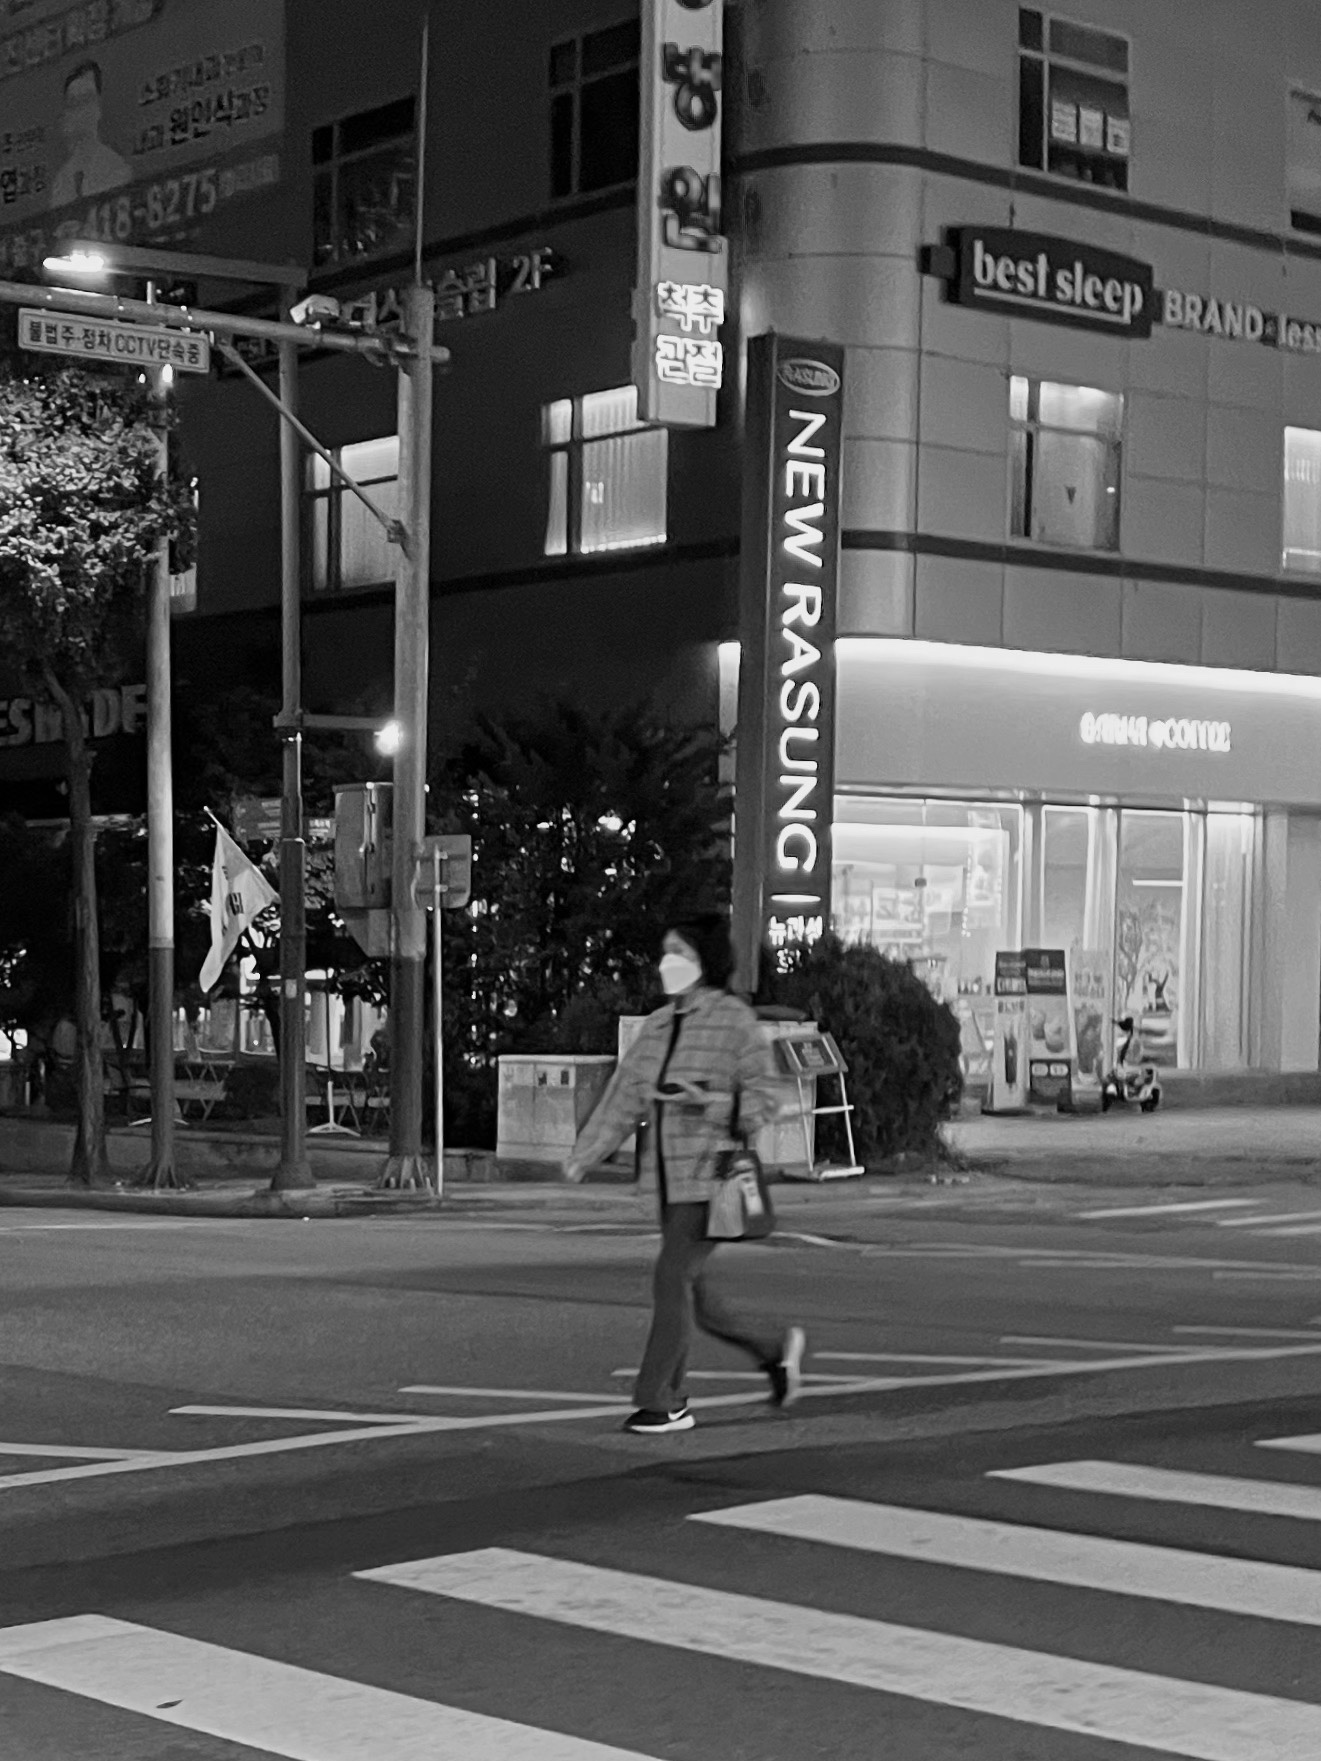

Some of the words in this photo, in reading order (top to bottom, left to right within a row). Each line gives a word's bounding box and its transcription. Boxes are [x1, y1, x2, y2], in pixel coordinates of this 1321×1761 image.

[660, 0, 722, 255] 병원
[657, 279, 724, 335] 척추
[973, 239, 1047, 298] best
[1056, 260, 1144, 324] sleep
[1164, 289, 1264, 341] BRAND
[656, 333, 722, 390] 관절
[783, 410, 827, 569] NEW
[776, 580, 824, 873] RASUNG
